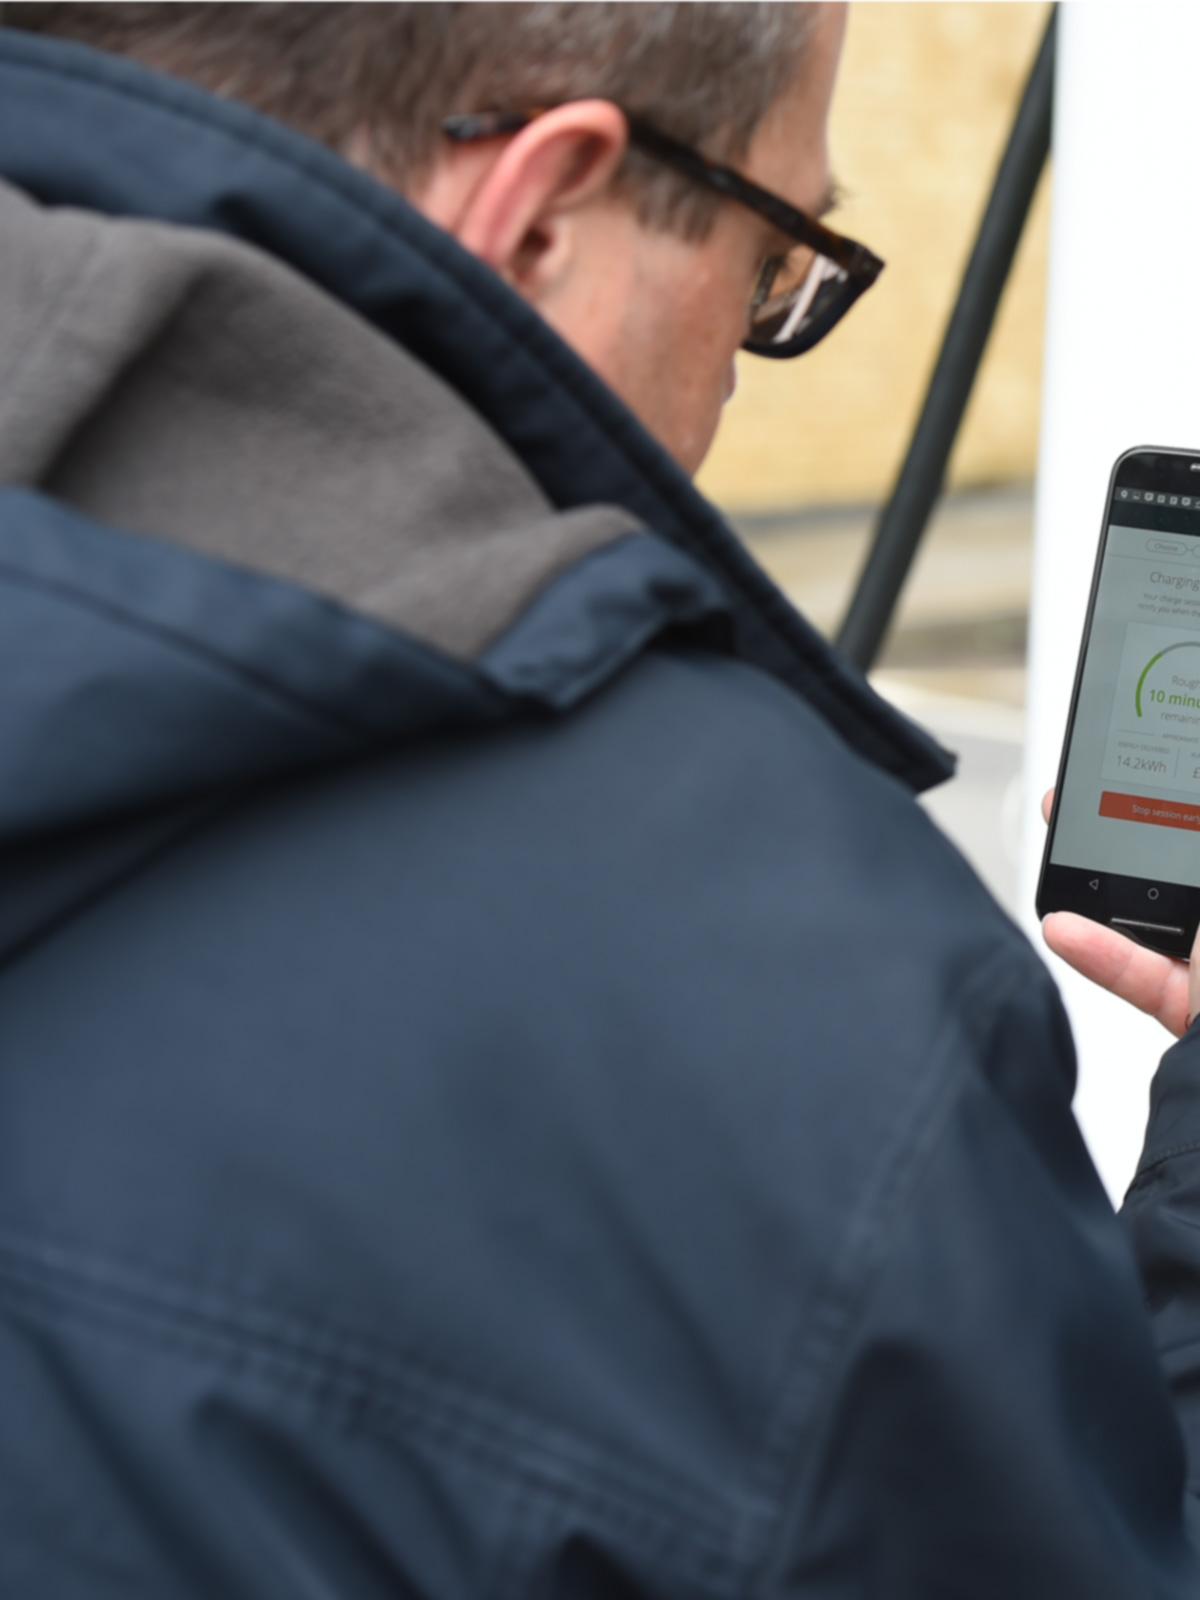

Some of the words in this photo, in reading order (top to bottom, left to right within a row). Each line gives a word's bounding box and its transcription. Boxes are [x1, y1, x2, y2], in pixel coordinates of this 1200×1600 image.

[1154, 543, 1179, 553] Choose
[1149, 571, 1200, 592] Charging
[1143, 591, 1158, 601] Your
[1159, 594, 1182, 606] charge
[1137, 602, 1157, 613] notify
[1157, 606, 1171, 615] you
[1171, 606, 1191, 617] when
[1149, 689, 1166, 704] 10
[1116, 755, 1167, 774] 14.2kWh
[1132, 804, 1151, 818] Stop
[1151, 807, 1182, 820] session
